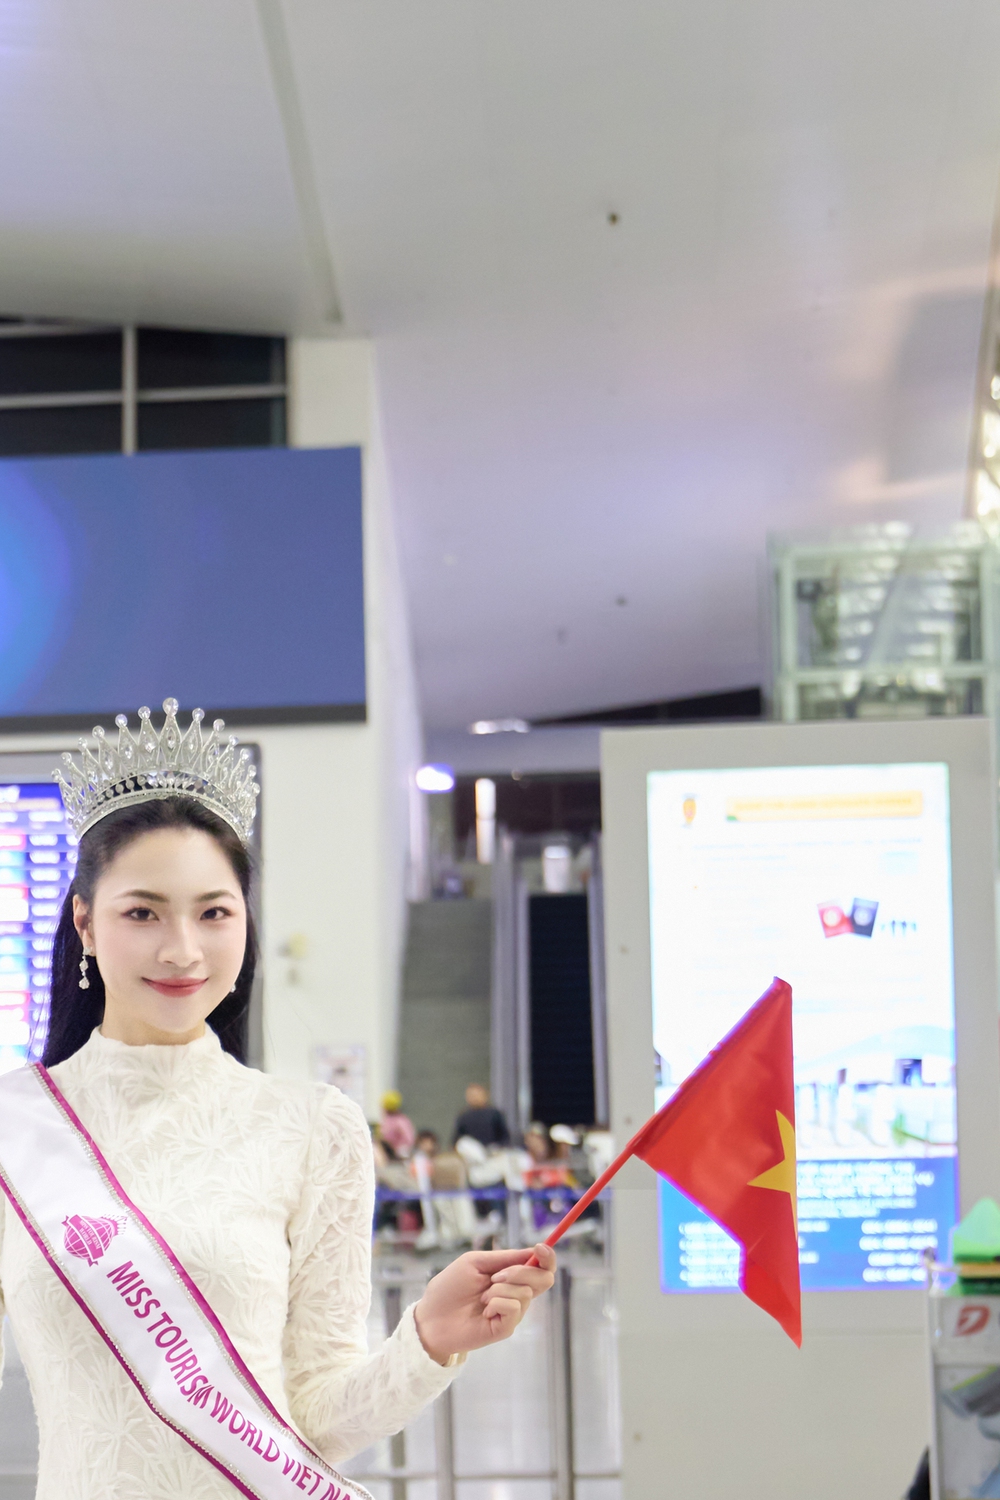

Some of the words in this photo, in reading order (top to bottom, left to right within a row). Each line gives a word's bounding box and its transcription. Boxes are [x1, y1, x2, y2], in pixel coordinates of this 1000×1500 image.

[106, 1260, 161, 1319] MISS
[146, 1311, 215, 1409] TOURISM
[210, 1391, 281, 1463] WORLD
[282, 1450, 324, 1496] VIET
